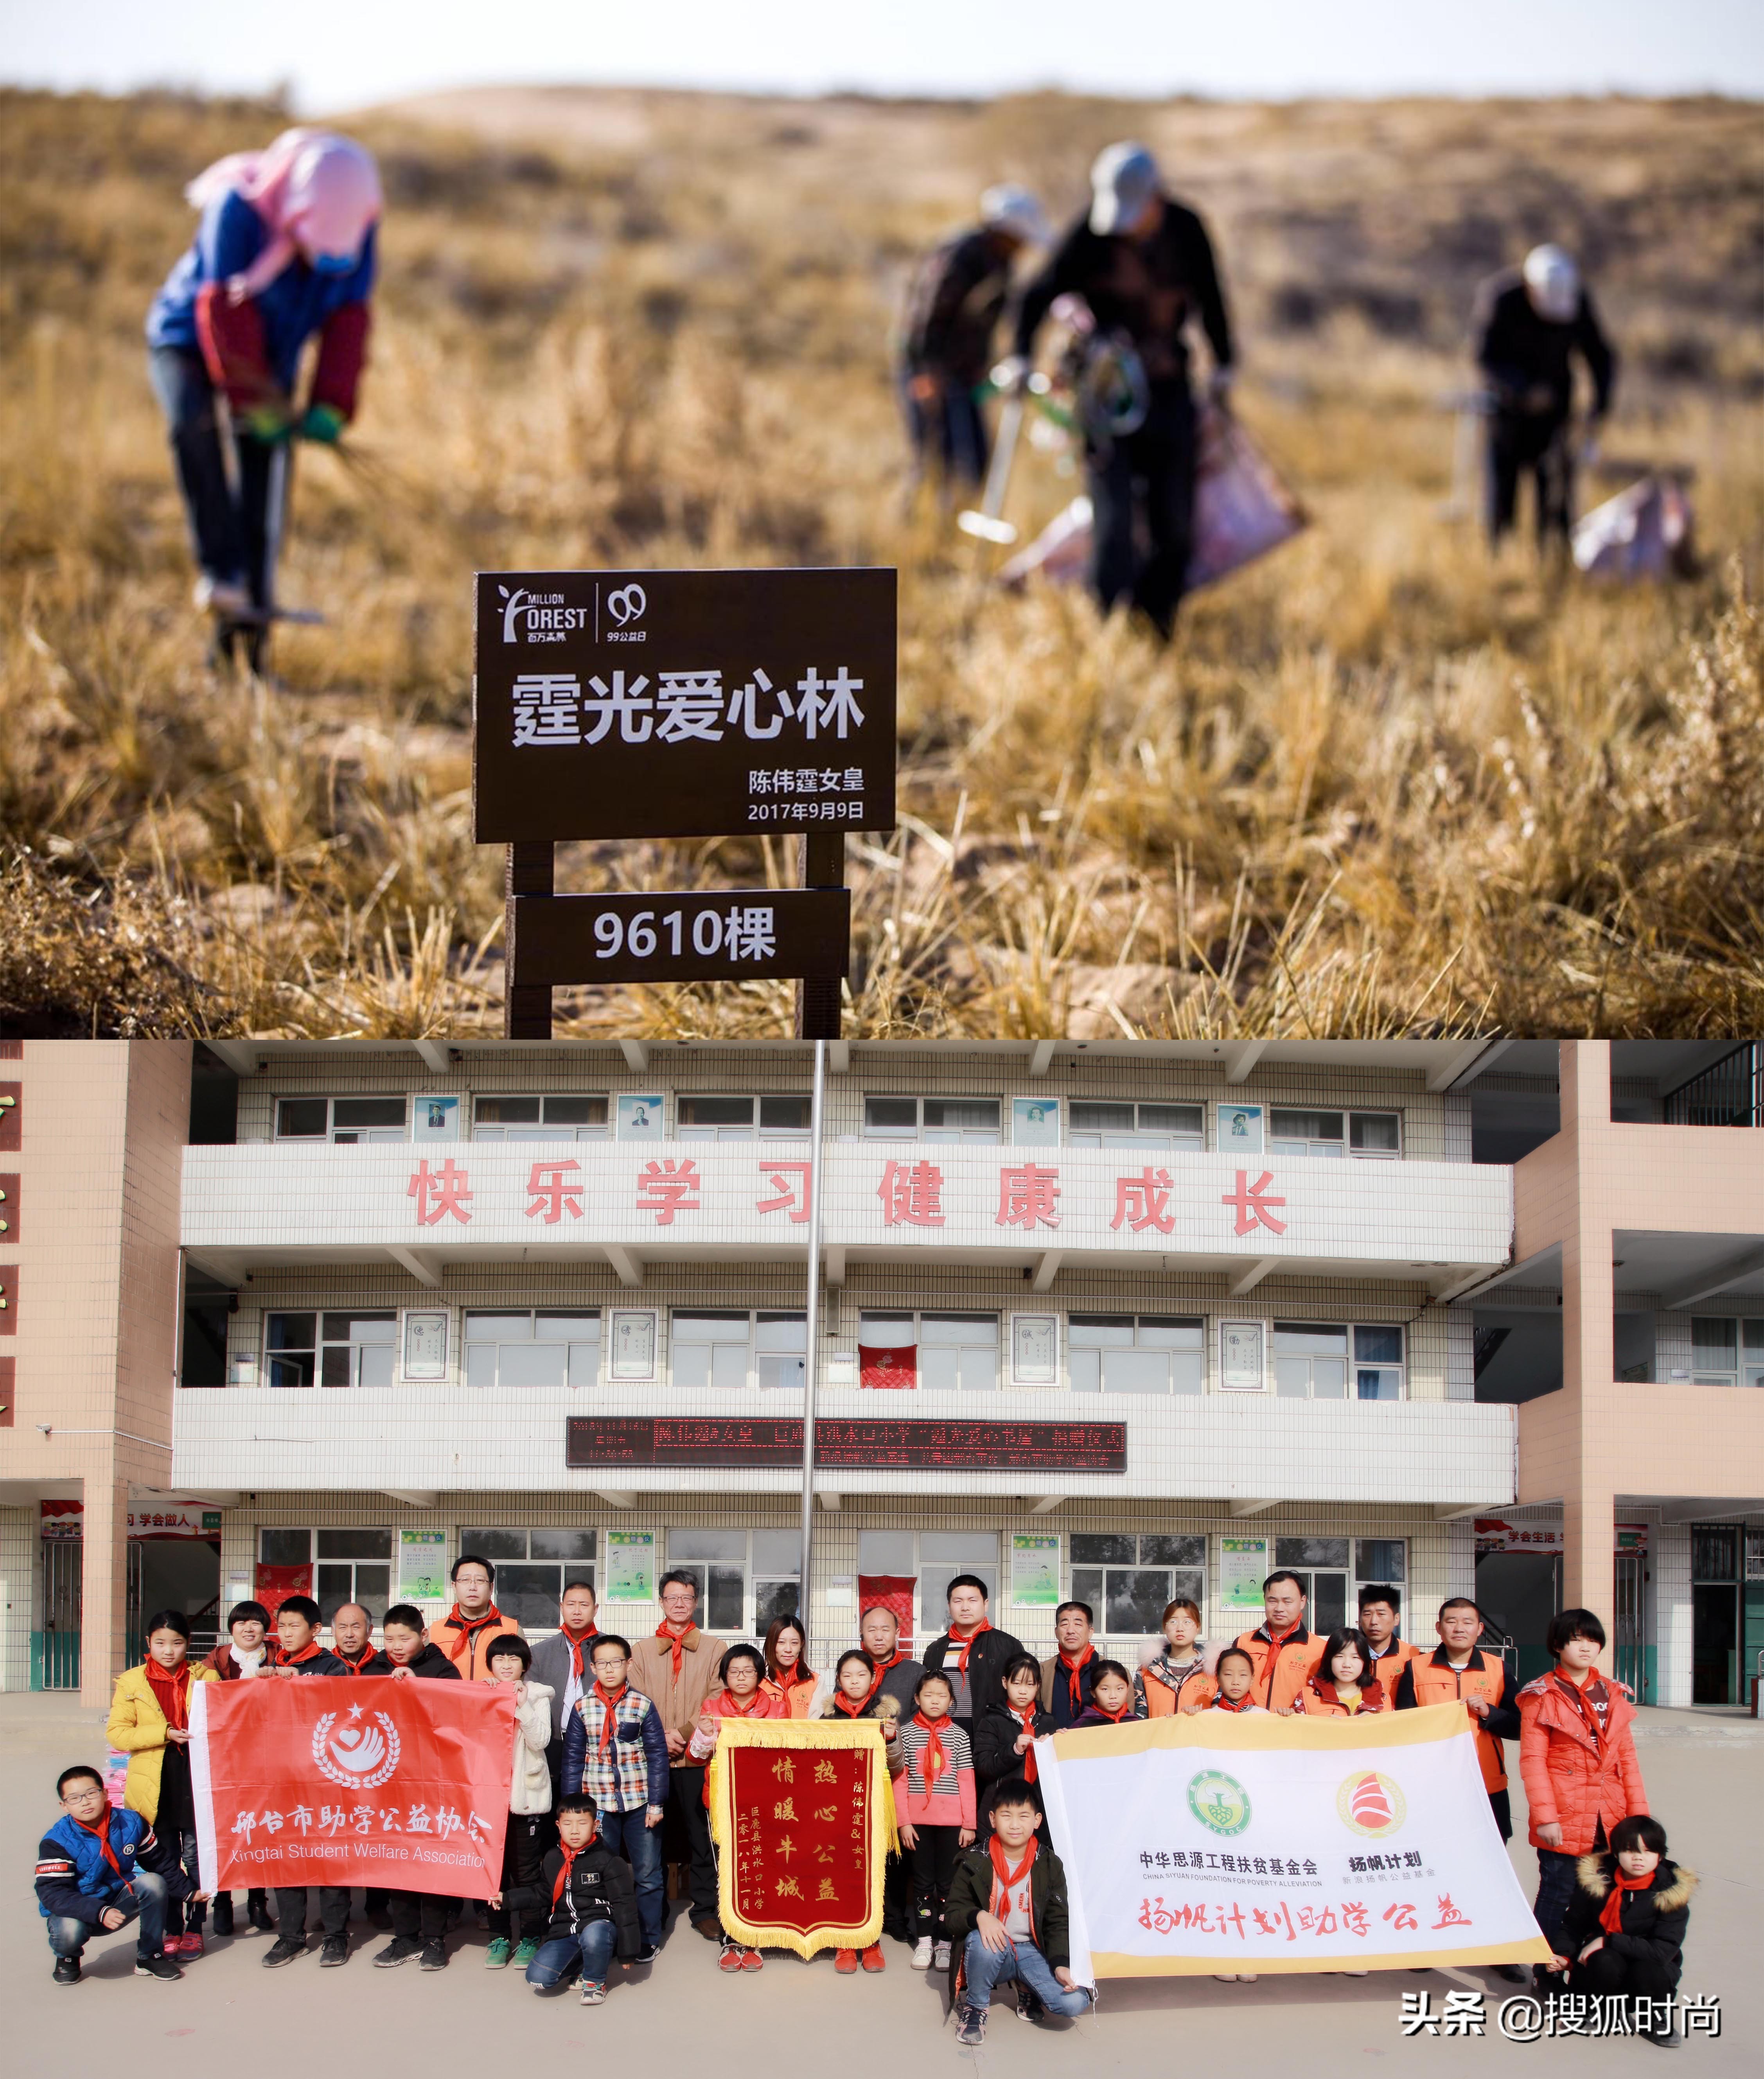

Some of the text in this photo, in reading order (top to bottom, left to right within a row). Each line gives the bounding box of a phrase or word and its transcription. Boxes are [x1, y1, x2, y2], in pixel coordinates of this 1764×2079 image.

[528, 594, 564, 604] MILLION
[607, 631, 647, 642] 99公益日
[512, 666, 865, 748] 霆光爱心林
[748, 767, 865, 794] 陈伟霆女皇
[747, 801, 864, 821] 2017年9月9日
[593, 906, 776, 961] 9610棵
[139, 1513, 190, 1527] 学会做人
[1508, 1531, 1555, 1543] 学会生活
[231, 1804, 492, 1845] 邢台市助学公益协会
[772, 1756, 805, 1901] 情暖牛城
[812, 1759, 839, 1901] 热心公益
[1205, 1821, 1241, 1835] SYGOC
[230, 1843, 485, 1869] Xingtai Student Welfare Association
[737, 1813, 751, 1910] 二零一八年十一月
[750, 1806, 765, 1910] 巨鹿县洪水口小学
[1140, 1851, 1318, 1876] 中华思源工程扶贫基金会
[1348, 1851, 1422, 1872] 扬帆计划
[1191, 1874, 1232, 1883] FOUNDATION
[1247, 1879, 1277, 1887] POVERTY
[1342, 1868, 1436, 1885] 新浪扬帆公益基金
[1138, 1892, 1473, 1941] 扬帆计划助学公益
